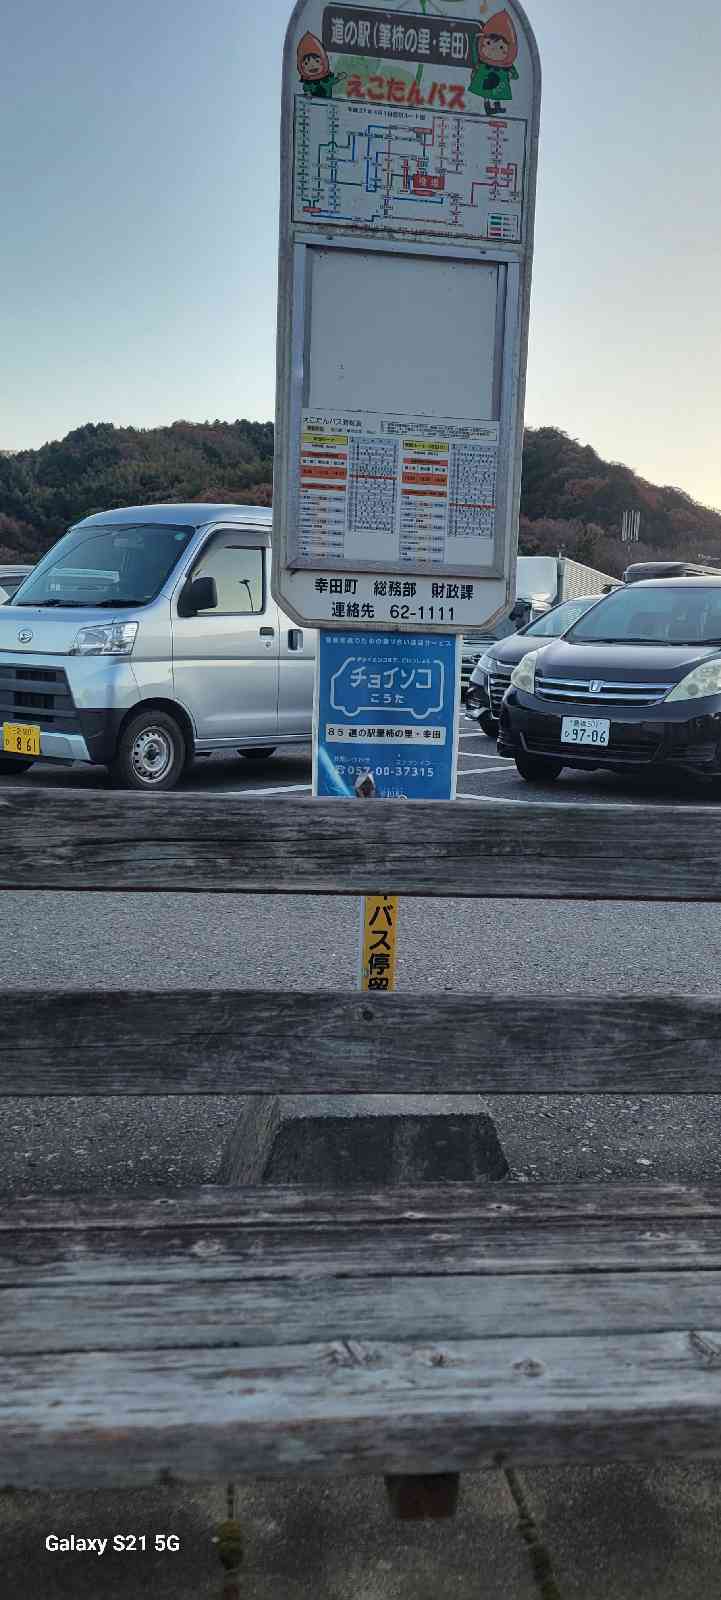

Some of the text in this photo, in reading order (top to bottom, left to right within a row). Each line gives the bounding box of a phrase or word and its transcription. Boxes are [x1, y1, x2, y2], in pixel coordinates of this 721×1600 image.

[346, 73, 466, 110] えこたんバス
[314, 578, 474, 600] 幸田町 総務部 財政課
[331, 602, 455, 621] 連絡先 62-1111
[350, 666, 432, 690] チョイソコ
[370, 693, 406, 704] こうた
[572, 728, 607, 744] 97-06
